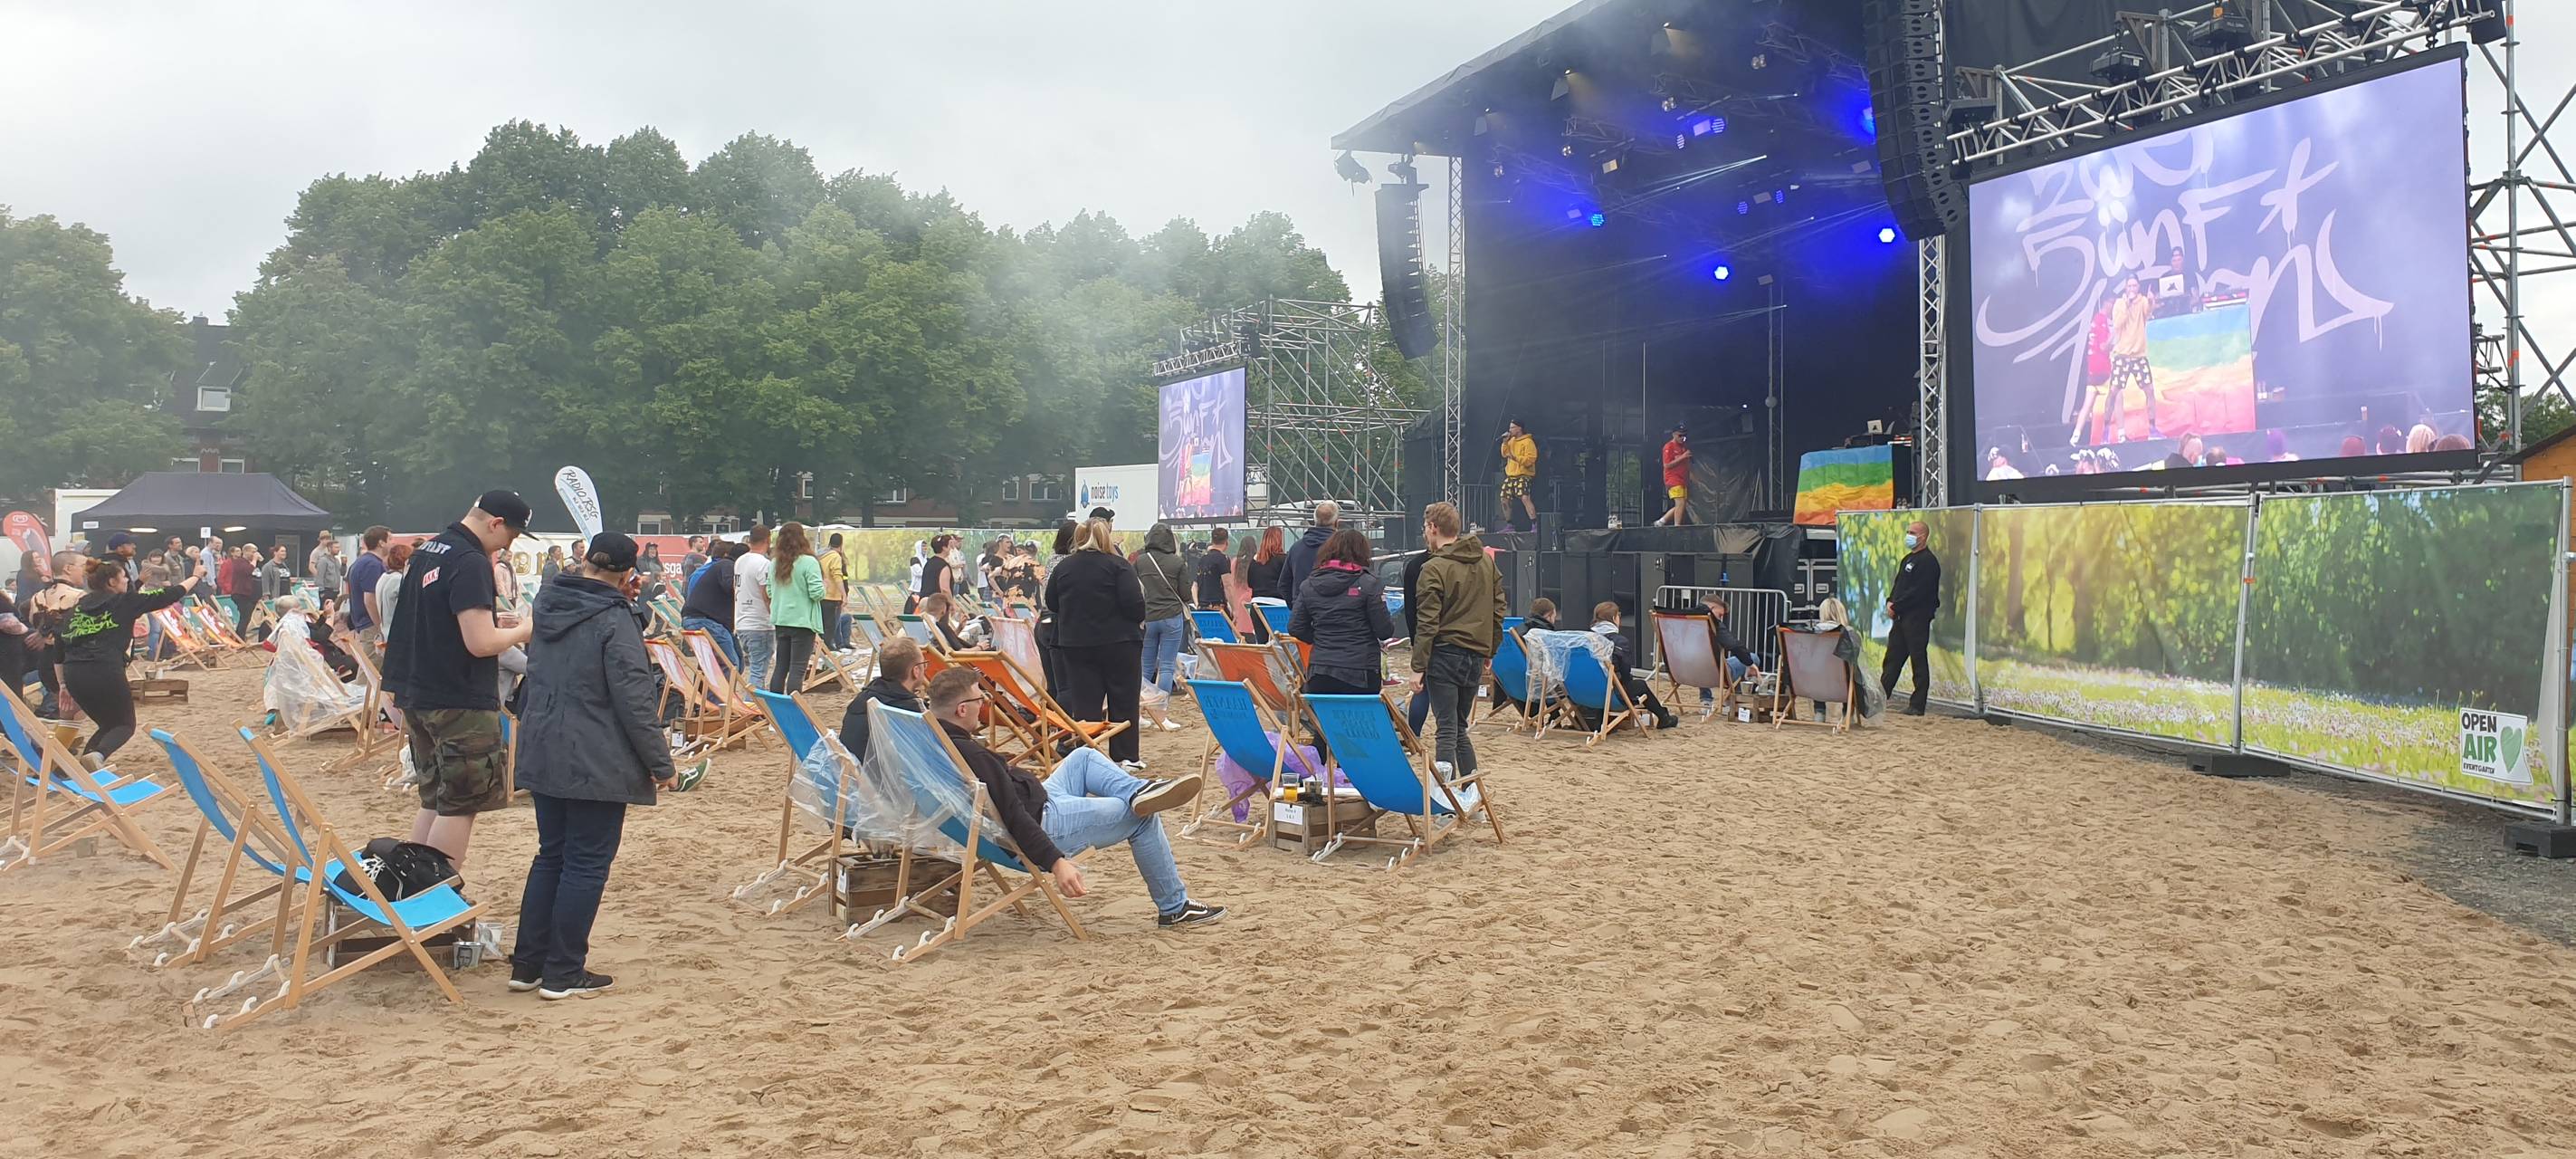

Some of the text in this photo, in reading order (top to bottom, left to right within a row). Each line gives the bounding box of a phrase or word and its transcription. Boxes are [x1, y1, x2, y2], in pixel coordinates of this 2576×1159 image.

[562, 469, 587, 498] RADIO
[582, 497, 599, 519] RSG
[1091, 482, 1119, 503] noise toys
[2462, 713, 2497, 733] OPEN
[2463, 733, 2497, 763] AIR
[2463, 762, 2495, 774] EVENTGARTEN
